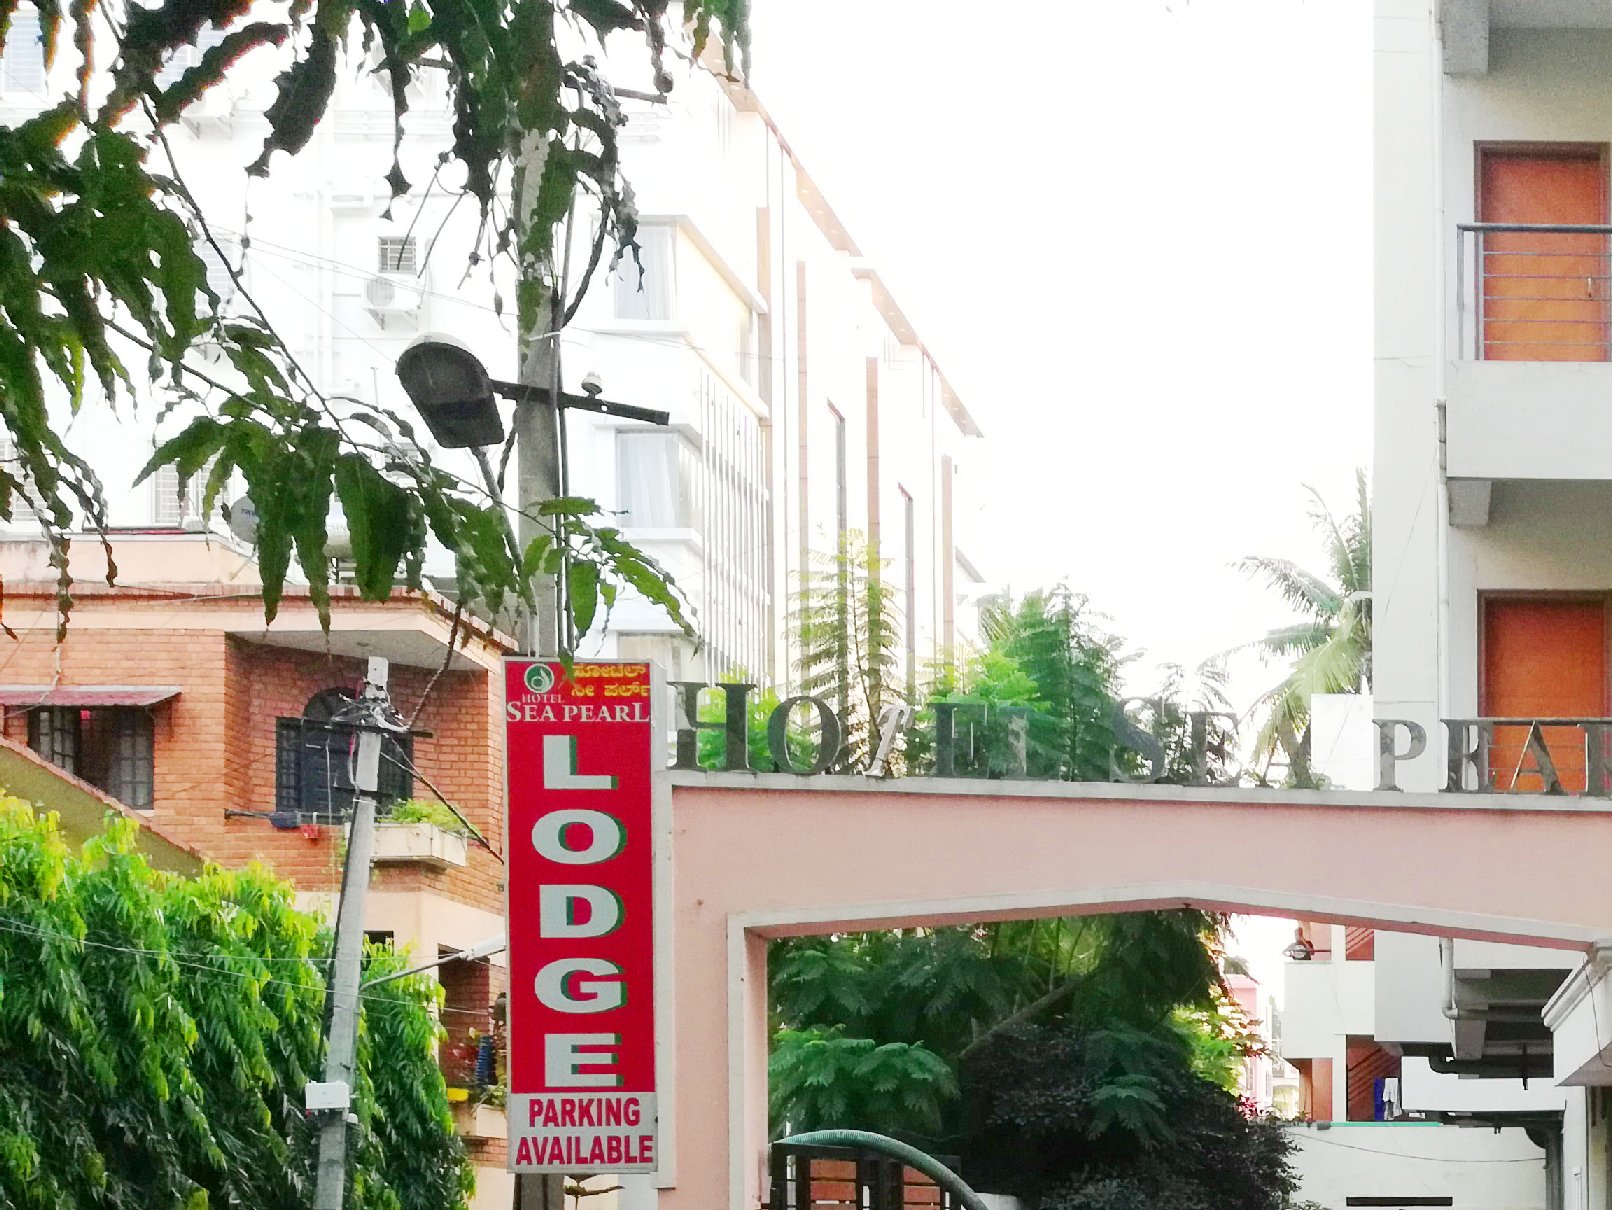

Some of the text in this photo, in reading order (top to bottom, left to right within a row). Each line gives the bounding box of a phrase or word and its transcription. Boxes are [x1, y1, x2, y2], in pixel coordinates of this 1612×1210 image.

[506, 701, 650, 722] SEA PEARL
[522, 693, 564, 704] HOTEL
[667, 681, 1072, 784] HOTEL
[1108, 697, 1326, 792] SEA
[531, 734, 628, 1088] LODGE
[529, 1097, 641, 1128] PARKING
[516, 1135, 653, 1165] AVAILABLE
